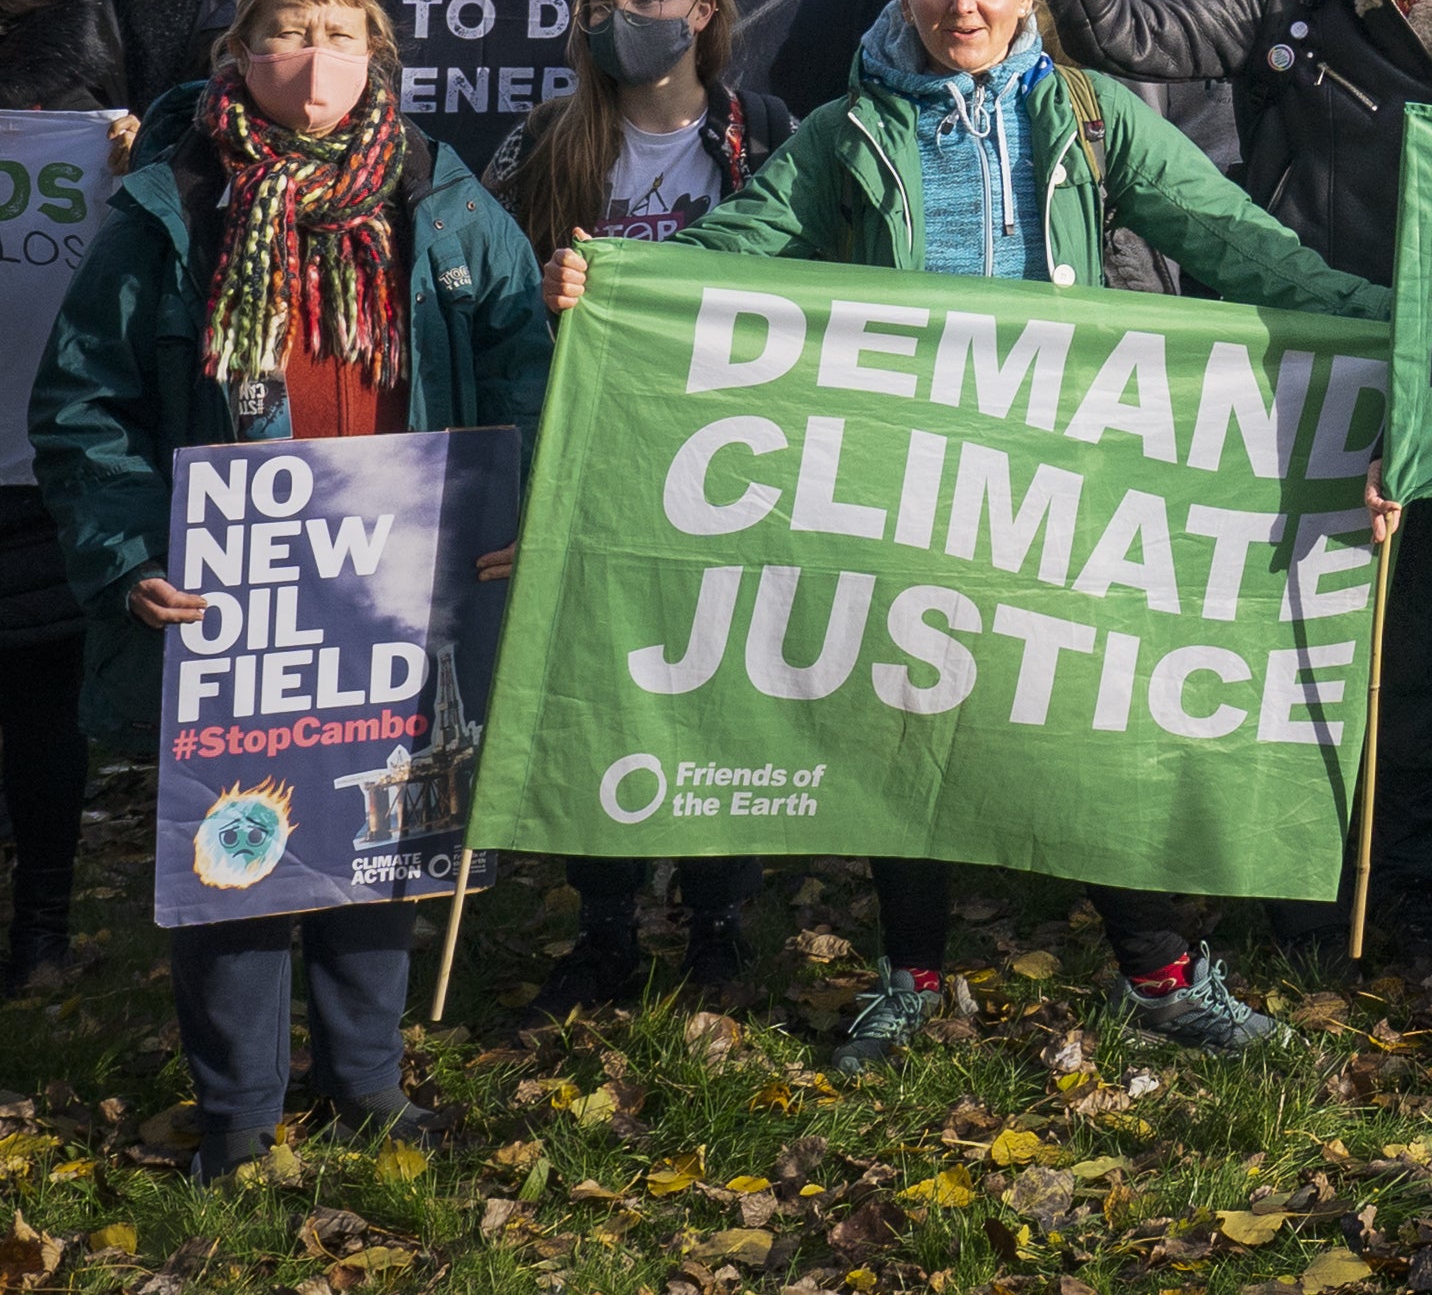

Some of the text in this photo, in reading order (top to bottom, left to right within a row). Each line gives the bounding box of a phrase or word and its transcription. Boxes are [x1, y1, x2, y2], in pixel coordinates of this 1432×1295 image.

[686, 286, 1389, 481] DEMAND
[187, 455, 314, 525] NO
[662, 415, 1374, 622] CLIMATE
[183, 513, 396, 590] NEW
[180, 585, 324, 656] OIL
[627, 565, 1357, 746] JUSTICE
[177, 641, 430, 723] FIELD
[172, 708, 429, 762] #StopCambo
[672, 792, 818, 817] the Earth
[675, 761, 827, 790] Friends of
[351, 852, 423, 871] CLIMATE
[351, 865, 423, 887] ACTION
